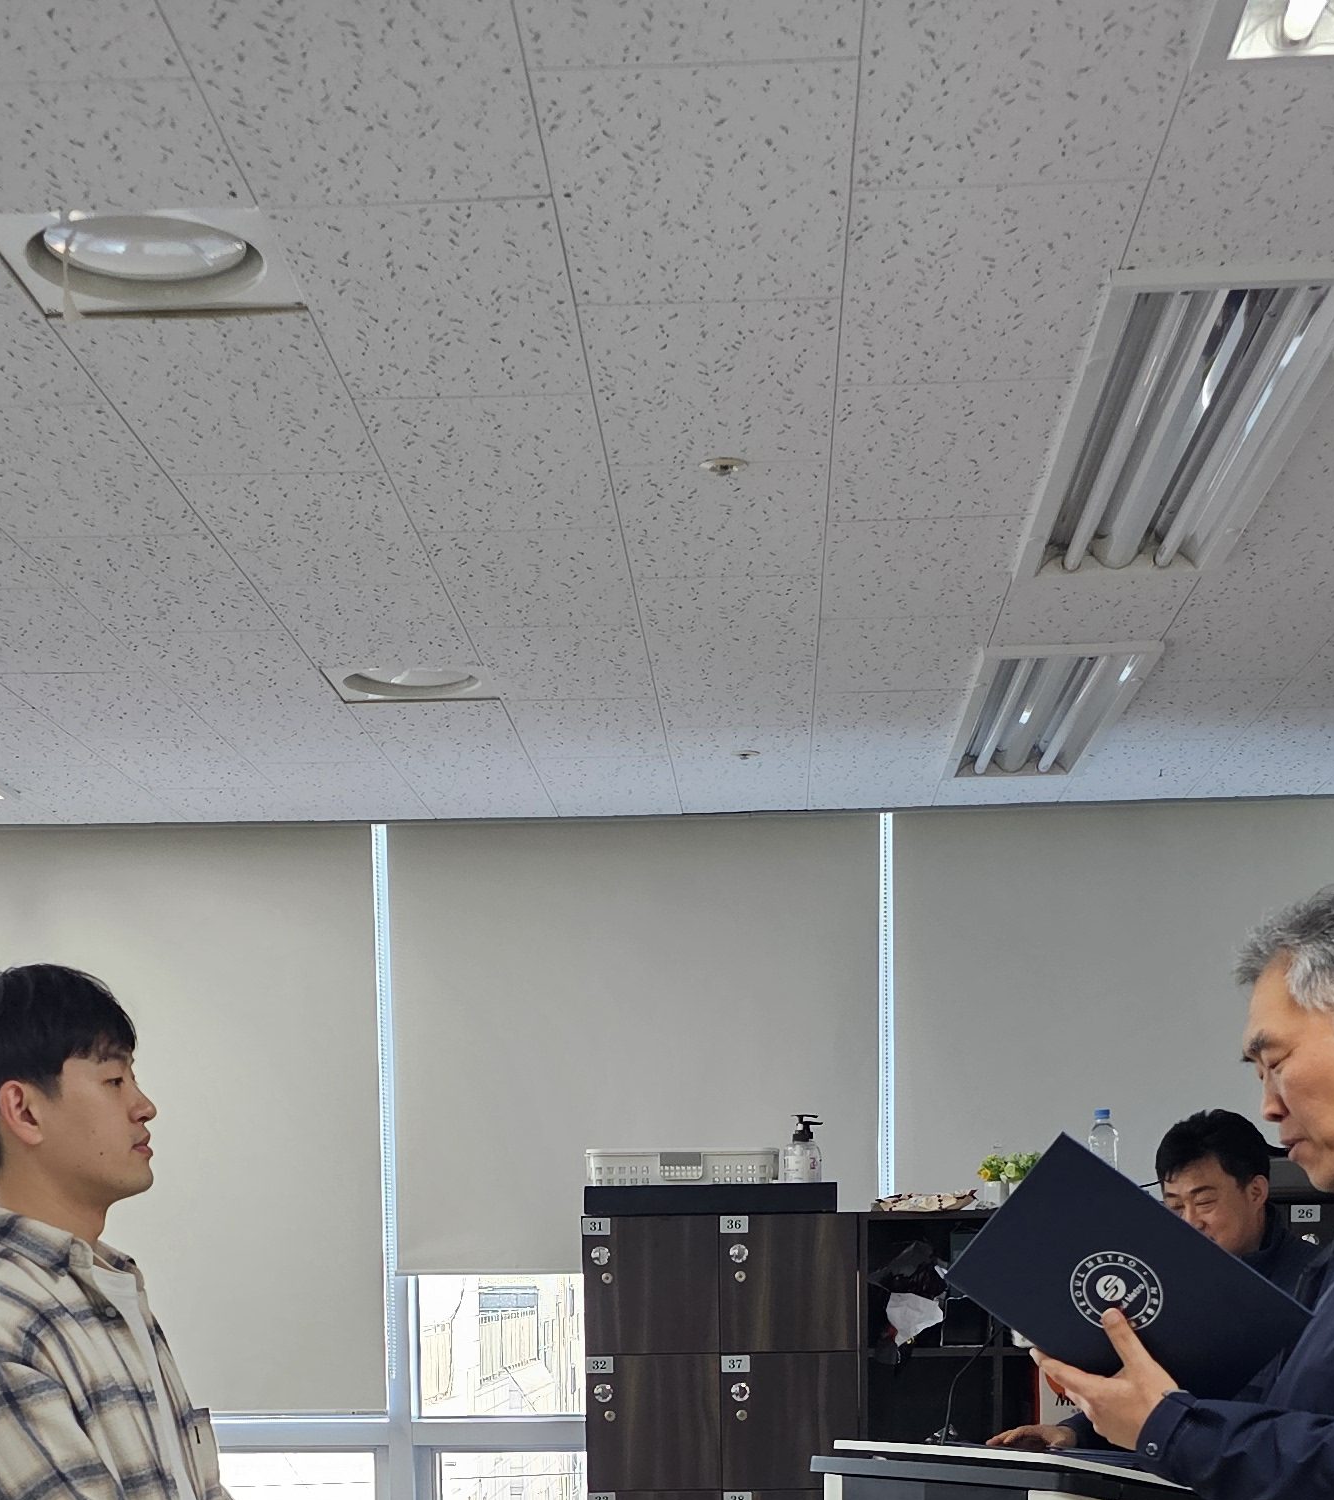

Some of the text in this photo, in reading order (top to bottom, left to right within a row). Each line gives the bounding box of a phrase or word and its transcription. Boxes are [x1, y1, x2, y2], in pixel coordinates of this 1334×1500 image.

[1297, 1208, 1313, 1219] 26
[589, 1221, 604, 1232] 31
[726, 1219, 742, 1230] 36
[1073, 1254, 1137, 1316] SEOUL METRO
[592, 1360, 607, 1370] 32
[728, 1359, 743, 1369] 37
